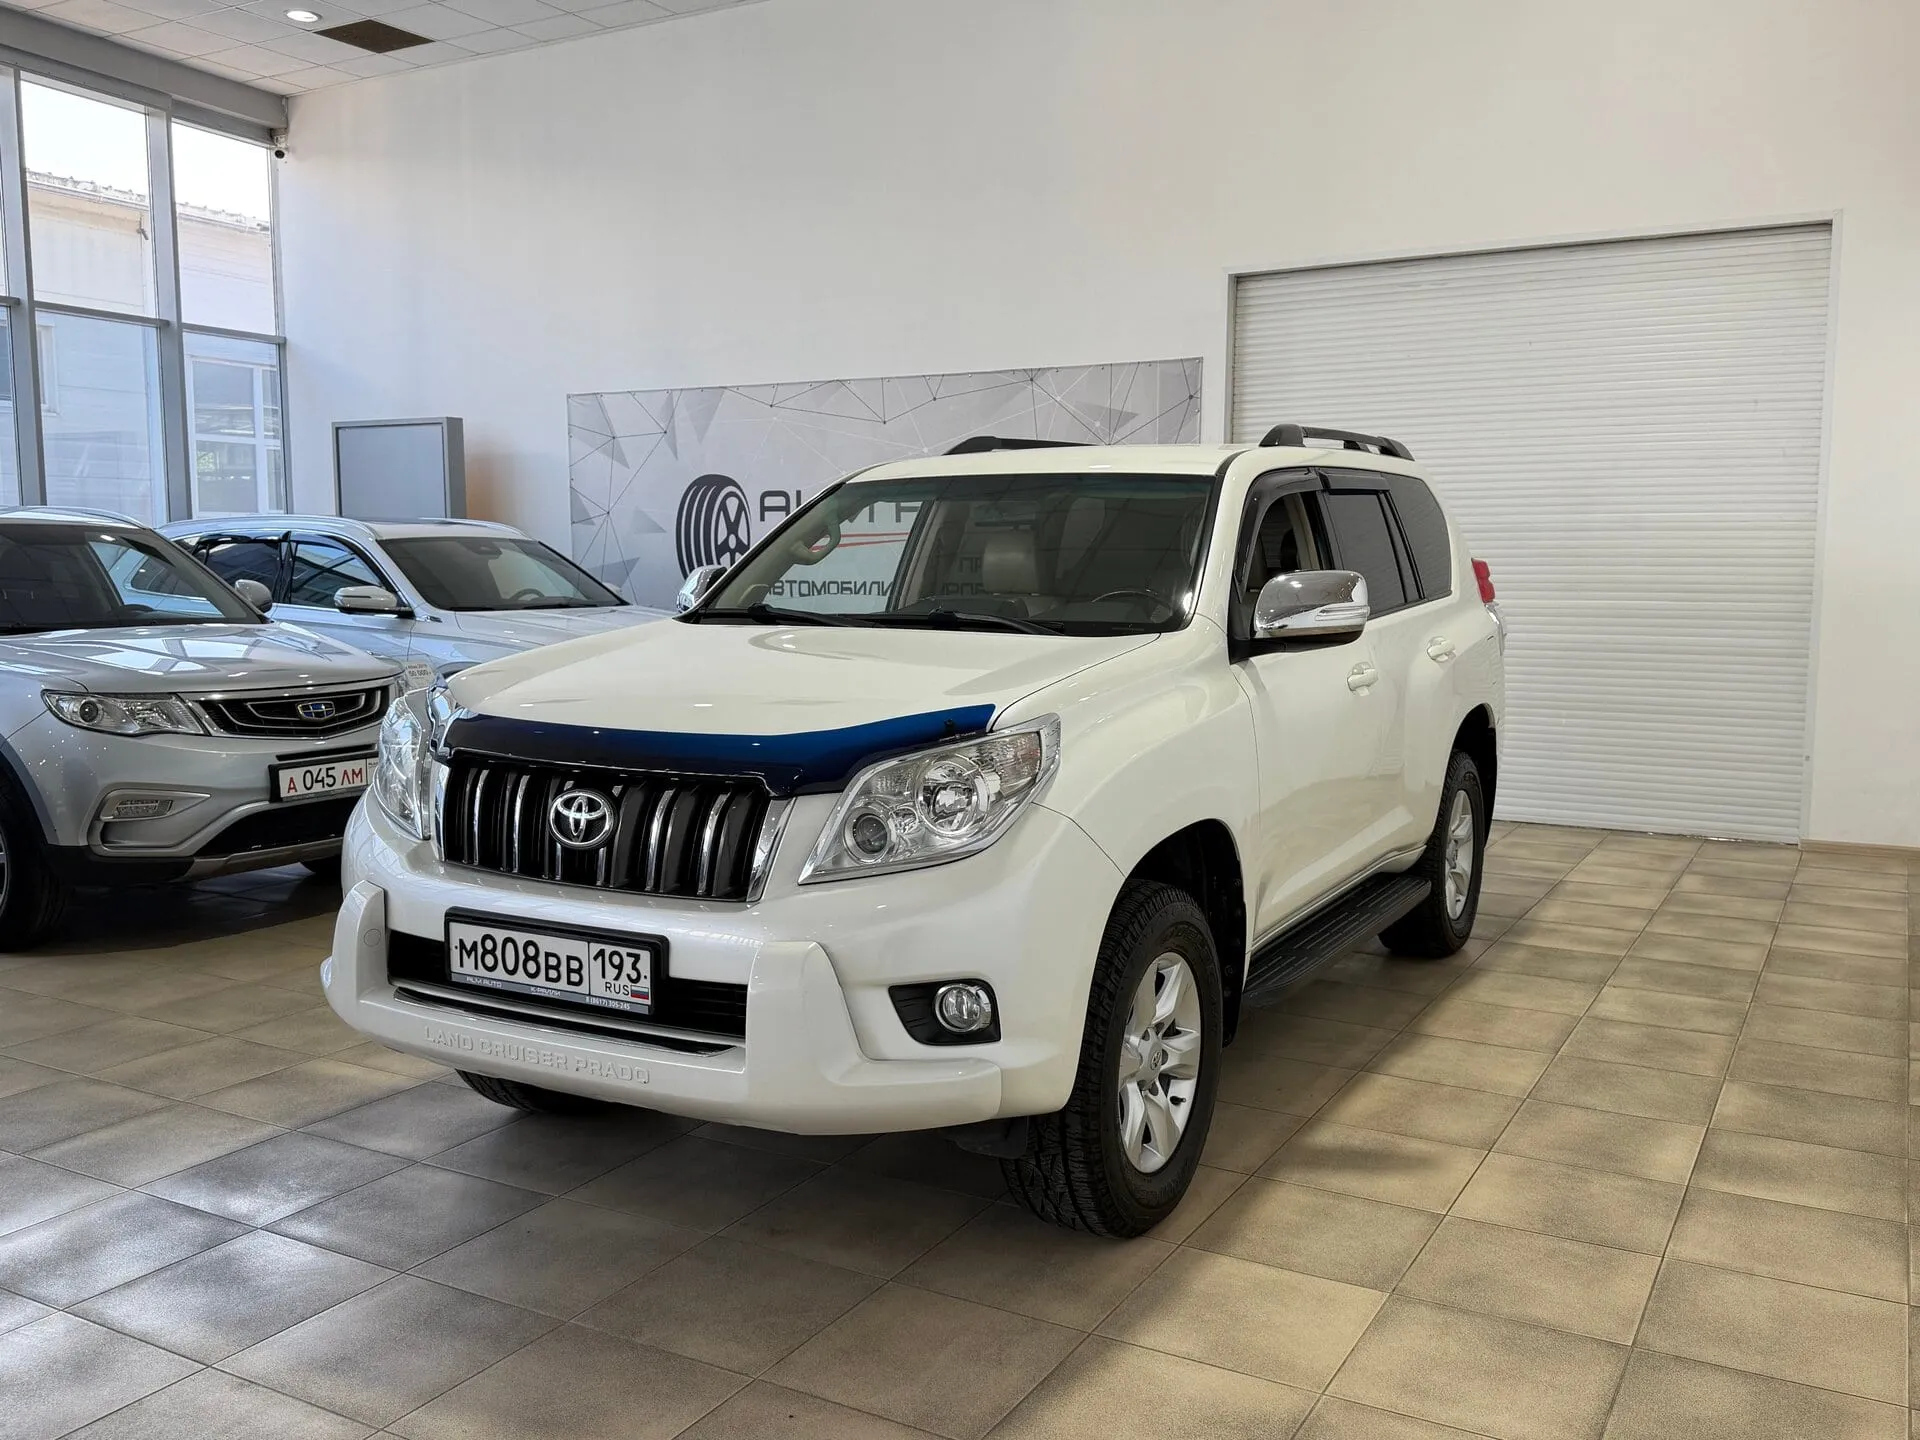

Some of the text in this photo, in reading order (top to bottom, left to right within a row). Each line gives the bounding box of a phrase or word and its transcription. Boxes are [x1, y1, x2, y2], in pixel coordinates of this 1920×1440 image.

[767, 580, 894, 597] ВТОМОБИЛИ
[303, 766, 337, 791] 045
[458, 934, 642, 987] М808ВВ 193
[604, 981, 630, 997] RUS
[424, 1026, 651, 1085] LAND CRUISER PRADO
